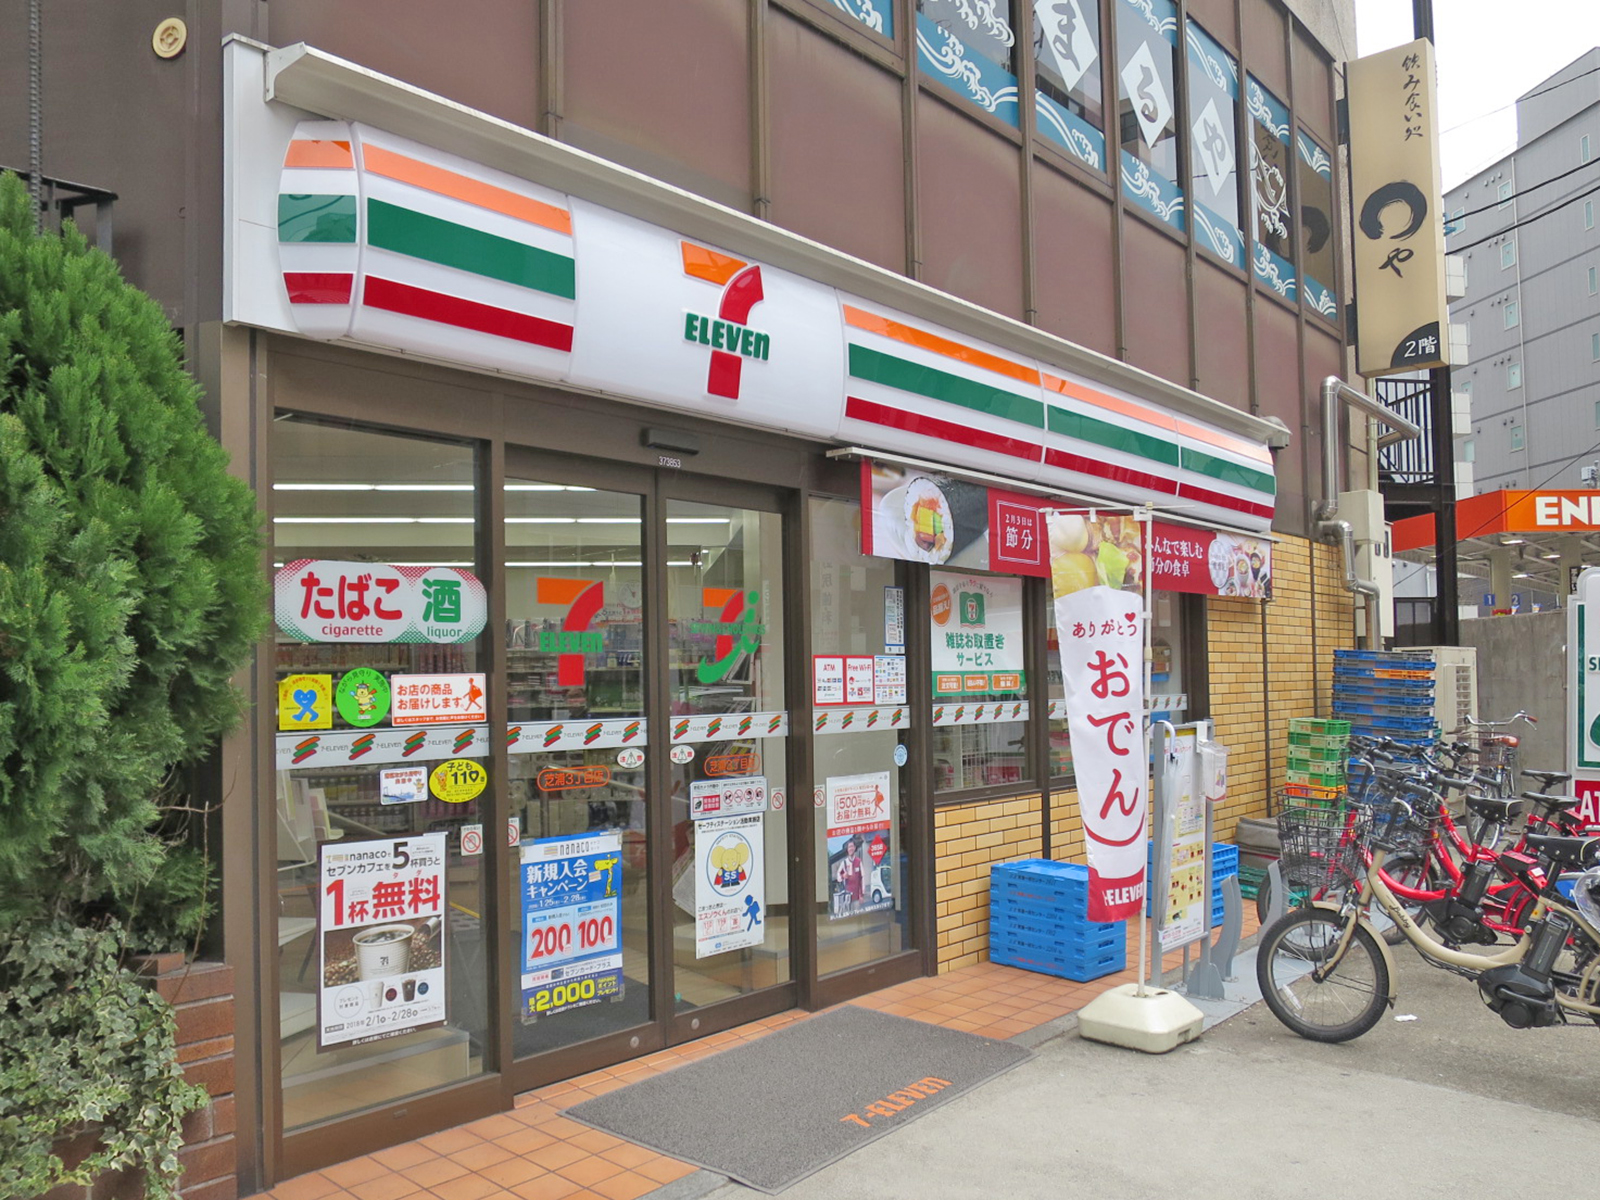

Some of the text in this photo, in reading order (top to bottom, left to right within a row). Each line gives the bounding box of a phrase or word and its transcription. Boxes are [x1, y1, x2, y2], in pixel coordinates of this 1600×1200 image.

[1404, 336, 1437, 358] 2階
[1005, 513, 1033, 527] 2月3日は
[1005, 526, 1033, 550] 節分
[301, 571, 402, 621] たばこ
[422, 578, 461, 623] 酒
[321, 624, 383, 638] cigarette
[427, 626, 462, 638] liquor
[1072, 618, 1137, 638] ありがとう
[945, 632, 1005, 650] 雑誌お取置き
[823, 664, 835, 672] ATM
[957, 653, 993, 666] サービス
[1588, 656, 1600, 672] S
[397, 683, 453, 696] お店の商品
[1087, 651, 1139, 819] おでん
[447, 762, 473, 772] 子ども
[560, 841, 589, 855] nanaco
[326, 862, 391, 877] セブンカフェを
[392, 842, 410, 869] 5
[526, 858, 588, 884] 新規入会
[724, 871, 737, 880] SS
[526, 878, 588, 899] キャンペーン
[531, 923, 571, 959] 200
[578, 916, 613, 949] 100
[536, 979, 595, 1012] 2,000
